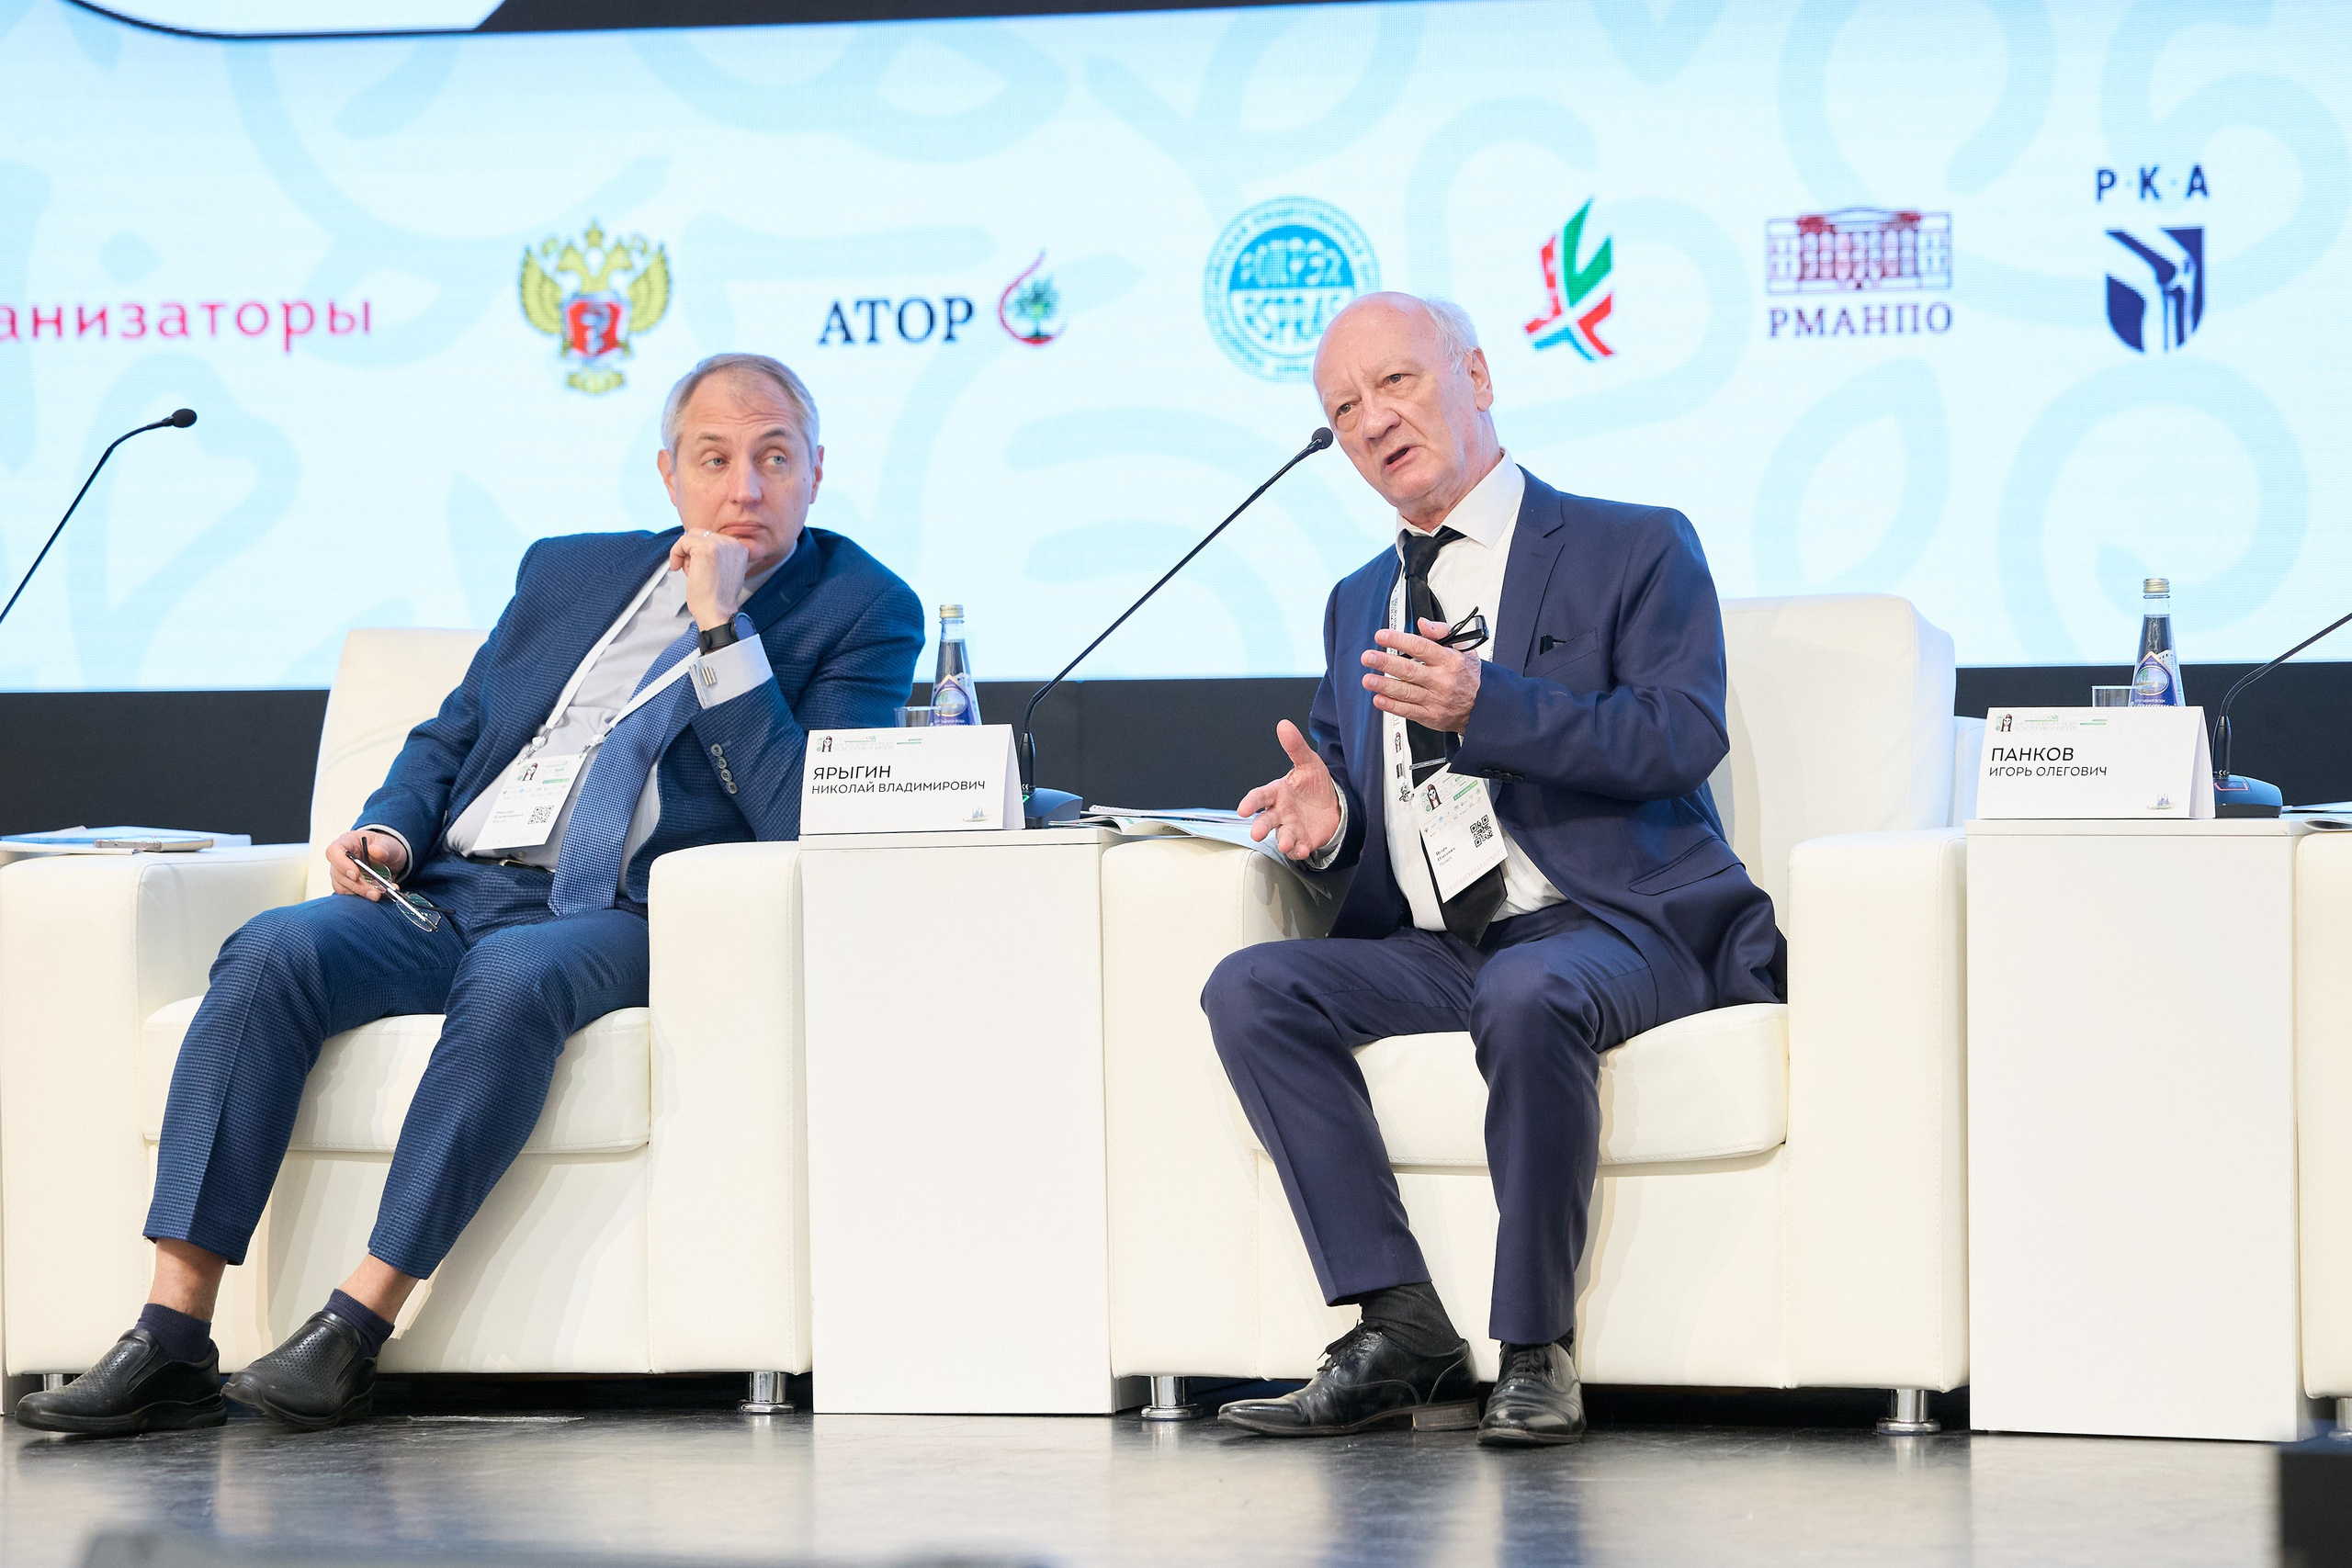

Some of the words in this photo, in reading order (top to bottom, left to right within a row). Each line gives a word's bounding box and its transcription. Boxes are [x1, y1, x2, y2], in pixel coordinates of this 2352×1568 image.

[819, 296, 975, 344] АТОР
[1767, 301, 1954, 341] РМАНПО
[1991, 747, 2075, 761] ПАНКОВ
[813, 765, 891, 781] ЯРЫГИН
[1989, 766, 2032, 777] ИГОРЬ
[2036, 766, 2108, 777] ОЛЕГОВИЧ
[811, 780, 876, 795] НИКОЛАЙ
[878, 780, 986, 794] ВЛАДИМИРОВИЧ
